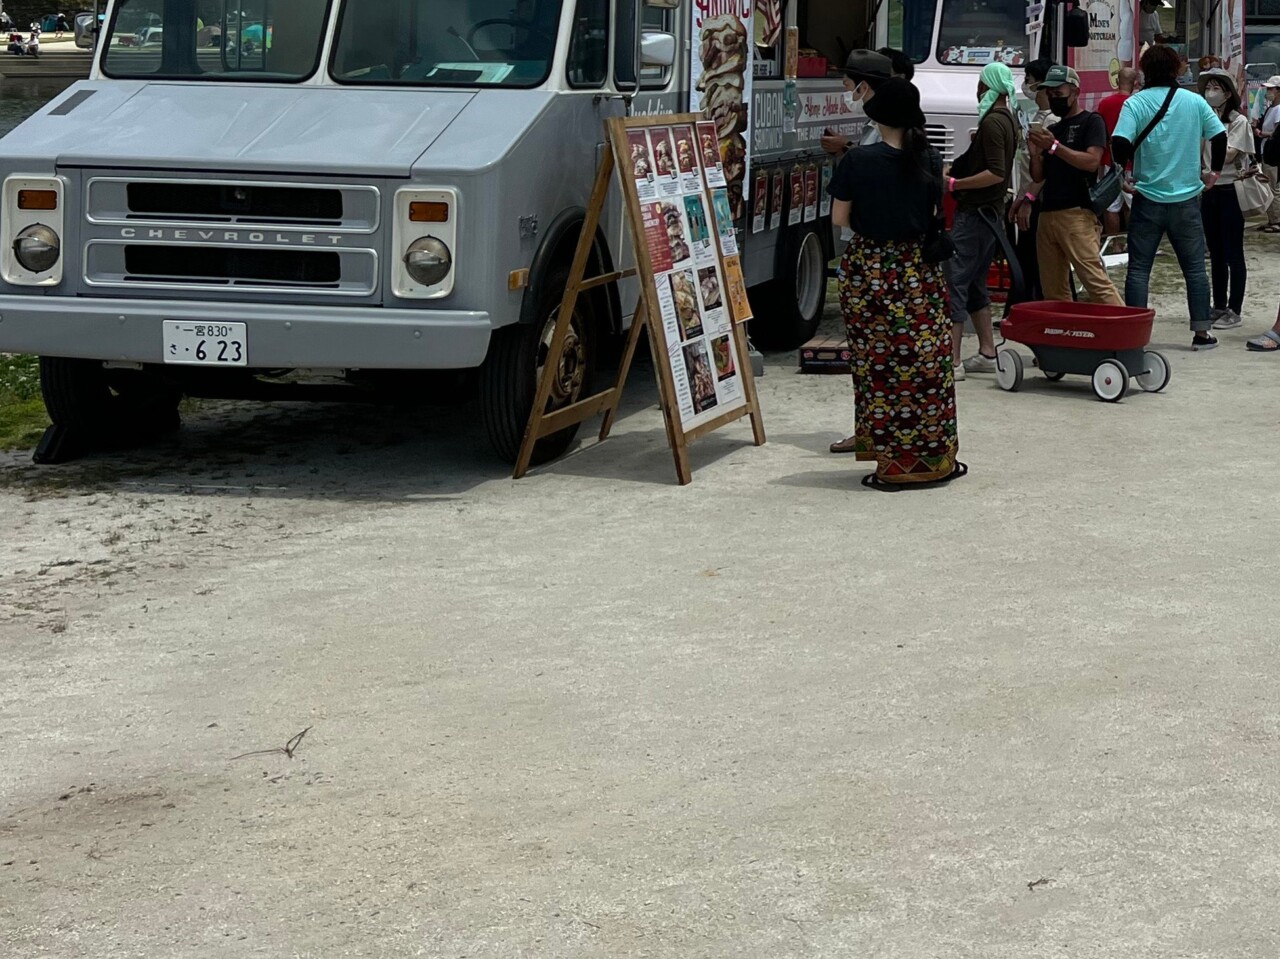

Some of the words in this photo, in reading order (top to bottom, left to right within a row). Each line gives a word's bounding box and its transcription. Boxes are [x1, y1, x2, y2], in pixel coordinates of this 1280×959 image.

[754, 92, 784, 128] CUBAN
[797, 128, 809, 141] THE
[120, 227, 342, 244] CHEVROLET
